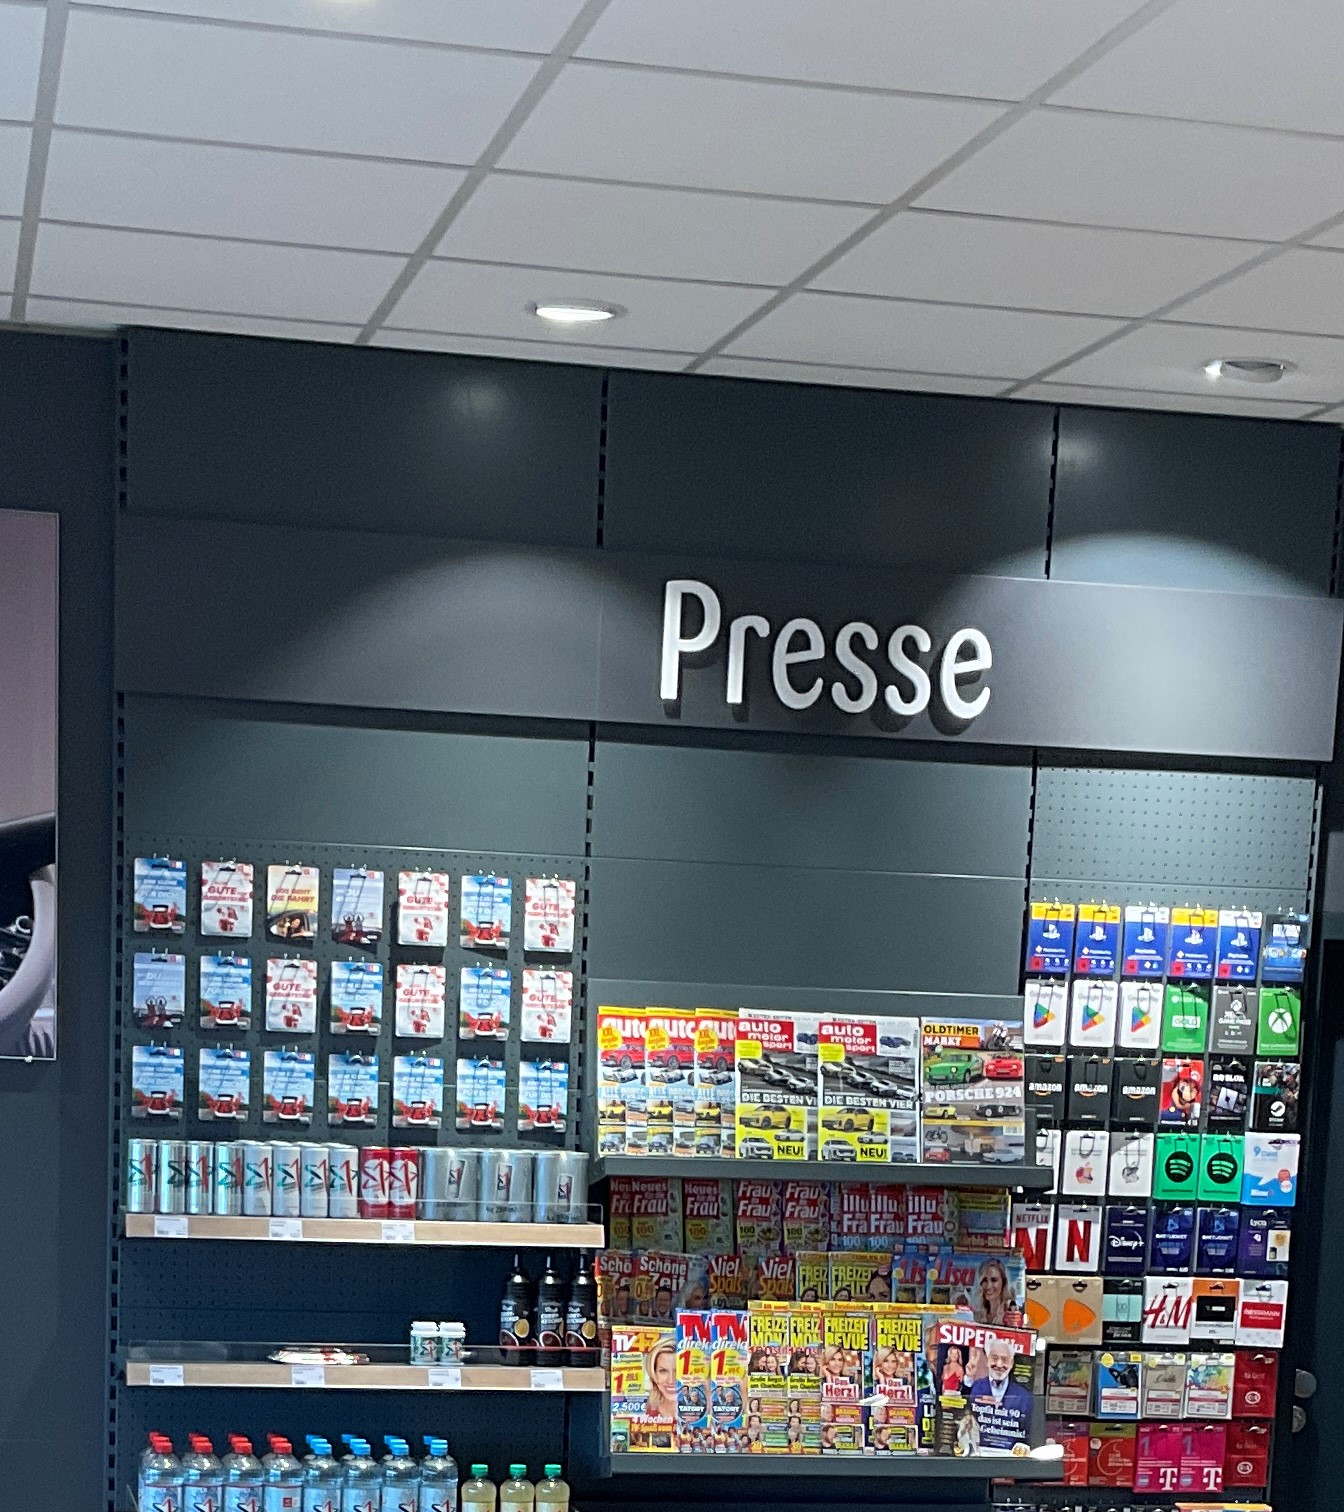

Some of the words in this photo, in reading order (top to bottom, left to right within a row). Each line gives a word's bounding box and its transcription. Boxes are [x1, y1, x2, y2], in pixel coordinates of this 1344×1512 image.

[659, 579, 993, 719] Presse
[738, 1021, 782, 1033] auto
[821, 1025, 864, 1036] auto
[923, 1025, 979, 1035] OLDTIMER
[747, 1032, 789, 1041] motor
[830, 1036, 872, 1044] motor
[924, 1037, 961, 1046] MARKT
[763, 1041, 792, 1050] sport
[846, 1044, 875, 1053] sport
[924, 1088, 994, 1103] PORSCHE
[996, 1086, 1022, 1099] 924
[1029, 1083, 1062, 1092] amazon
[1074, 1083, 1108, 1093] amazon
[1122, 1086, 1156, 1095] amazon
[742, 1093, 759, 1102] DIE
[762, 1094, 804, 1105] BESTEN
[824, 1095, 843, 1105] DIE
[846, 1096, 887, 1107] BESTEN
[888, 1099, 913, 1110] VIER
[777, 1145, 804, 1157] NEU!
[860, 1147, 887, 1158] NEU!
[632, 1181, 667, 1192] Neues
[685, 1183, 718, 1195] Neues
[738, 1181, 771, 1198] Frau
[785, 1182, 820, 1199] Frau
[633, 1195, 667, 1213] Frau
[686, 1197, 718, 1216] Frau
[737, 1200, 771, 1217] Frau
[870, 1190, 898, 1213] illu
[908, 1191, 936, 1213] illu
[785, 1201, 820, 1218] Frau
[843, 1214, 868, 1233] Fra
[870, 1214, 904, 1233] Frau
[907, 1214, 943, 1234] Frau
[1016, 1214, 1049, 1223] NETFLIX
[739, 1226, 755, 1234] 100
[786, 1226, 803, 1236] 100
[1066, 1219, 1092, 1263] N
[600, 1256, 632, 1273] Schö
[640, 1256, 686, 1275] Schöne
[711, 1255, 739, 1277] Viel
[761, 1257, 794, 1279] Viel
[935, 1256, 977, 1285] Lisa
[1143, 1293, 1194, 1330] H&M
[713, 1313, 748, 1342] TV
[791, 1317, 820, 1332] FREIZ
[824, 1317, 868, 1334] FREIZEIT
[877, 1319, 922, 1335] FREIZEIT
[613, 1334, 637, 1351] TV
[751, 1332, 788, 1347] MONA
[791, 1332, 820, 1347] MON
[824, 1333, 868, 1350] REVUE
[825, 1385, 857, 1397] Herz!
[878, 1386, 910, 1399] Herz!
[971, 1403, 993, 1415] Topfit
[995, 1408, 1008, 1416] mit
[1009, 1410, 1020, 1418] 90
[640, 1414, 674, 1424] Wochen
[978, 1414, 991, 1424] das
[992, 1417, 1001, 1425] ist
[1002, 1419, 1019, 1427] sein
[980, 1425, 1026, 1438] Geheimnis!
